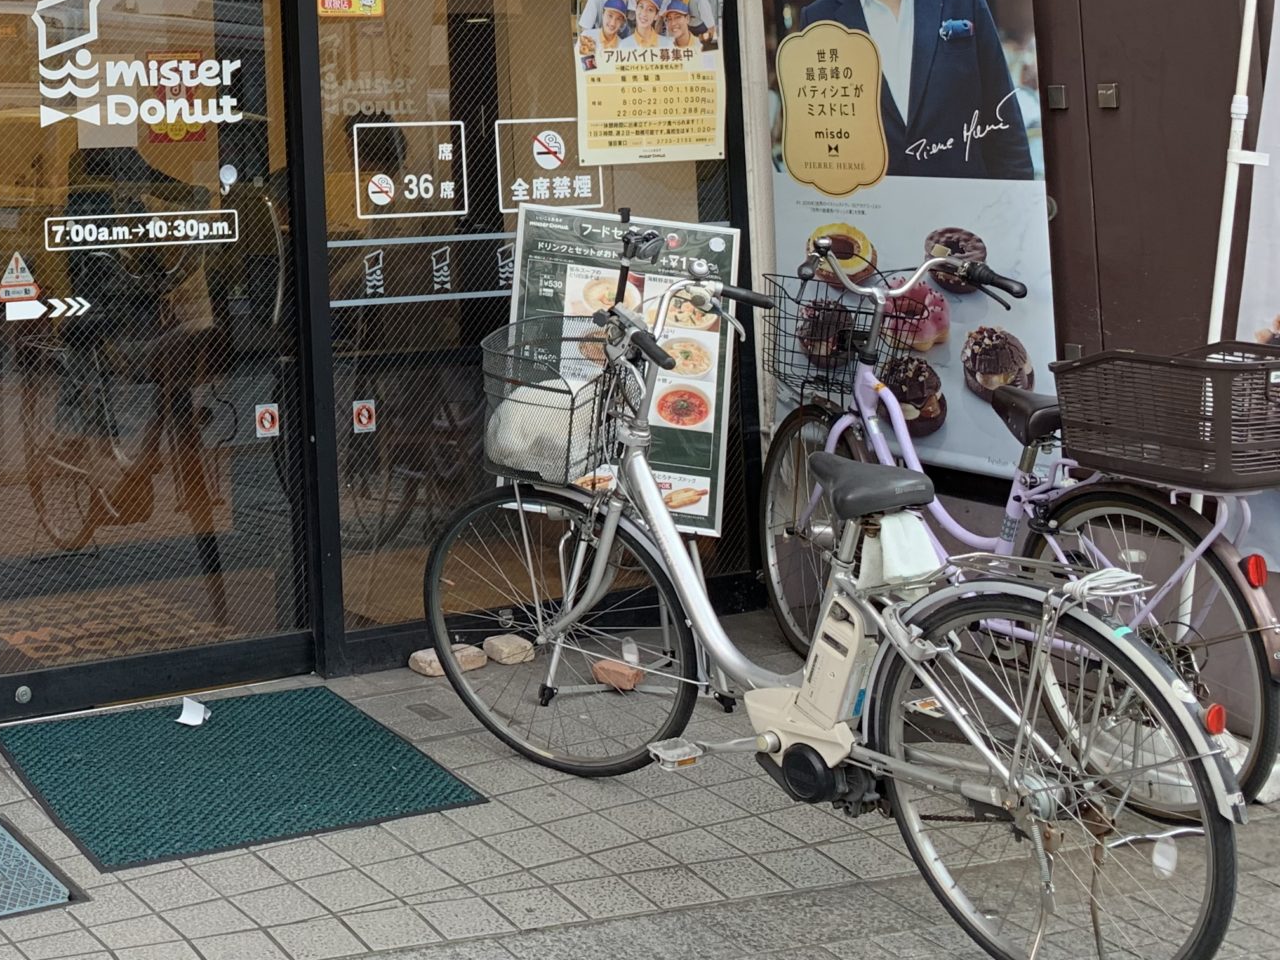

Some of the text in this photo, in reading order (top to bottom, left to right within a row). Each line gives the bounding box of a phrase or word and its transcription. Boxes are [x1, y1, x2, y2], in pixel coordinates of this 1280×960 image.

[603, 48, 694, 63] アルバイト募集中
[816, 48, 840, 63] 世界
[805, 66, 853, 81] 最高峰の
[106, 94, 243, 125] Donut
[814, 128, 851, 140] misdo
[437, 142, 454, 161] 席
[804, 161, 834, 170] PIERRE
[403, 173, 455, 200] 36 席
[510, 176, 593, 201] 全席禁煙
